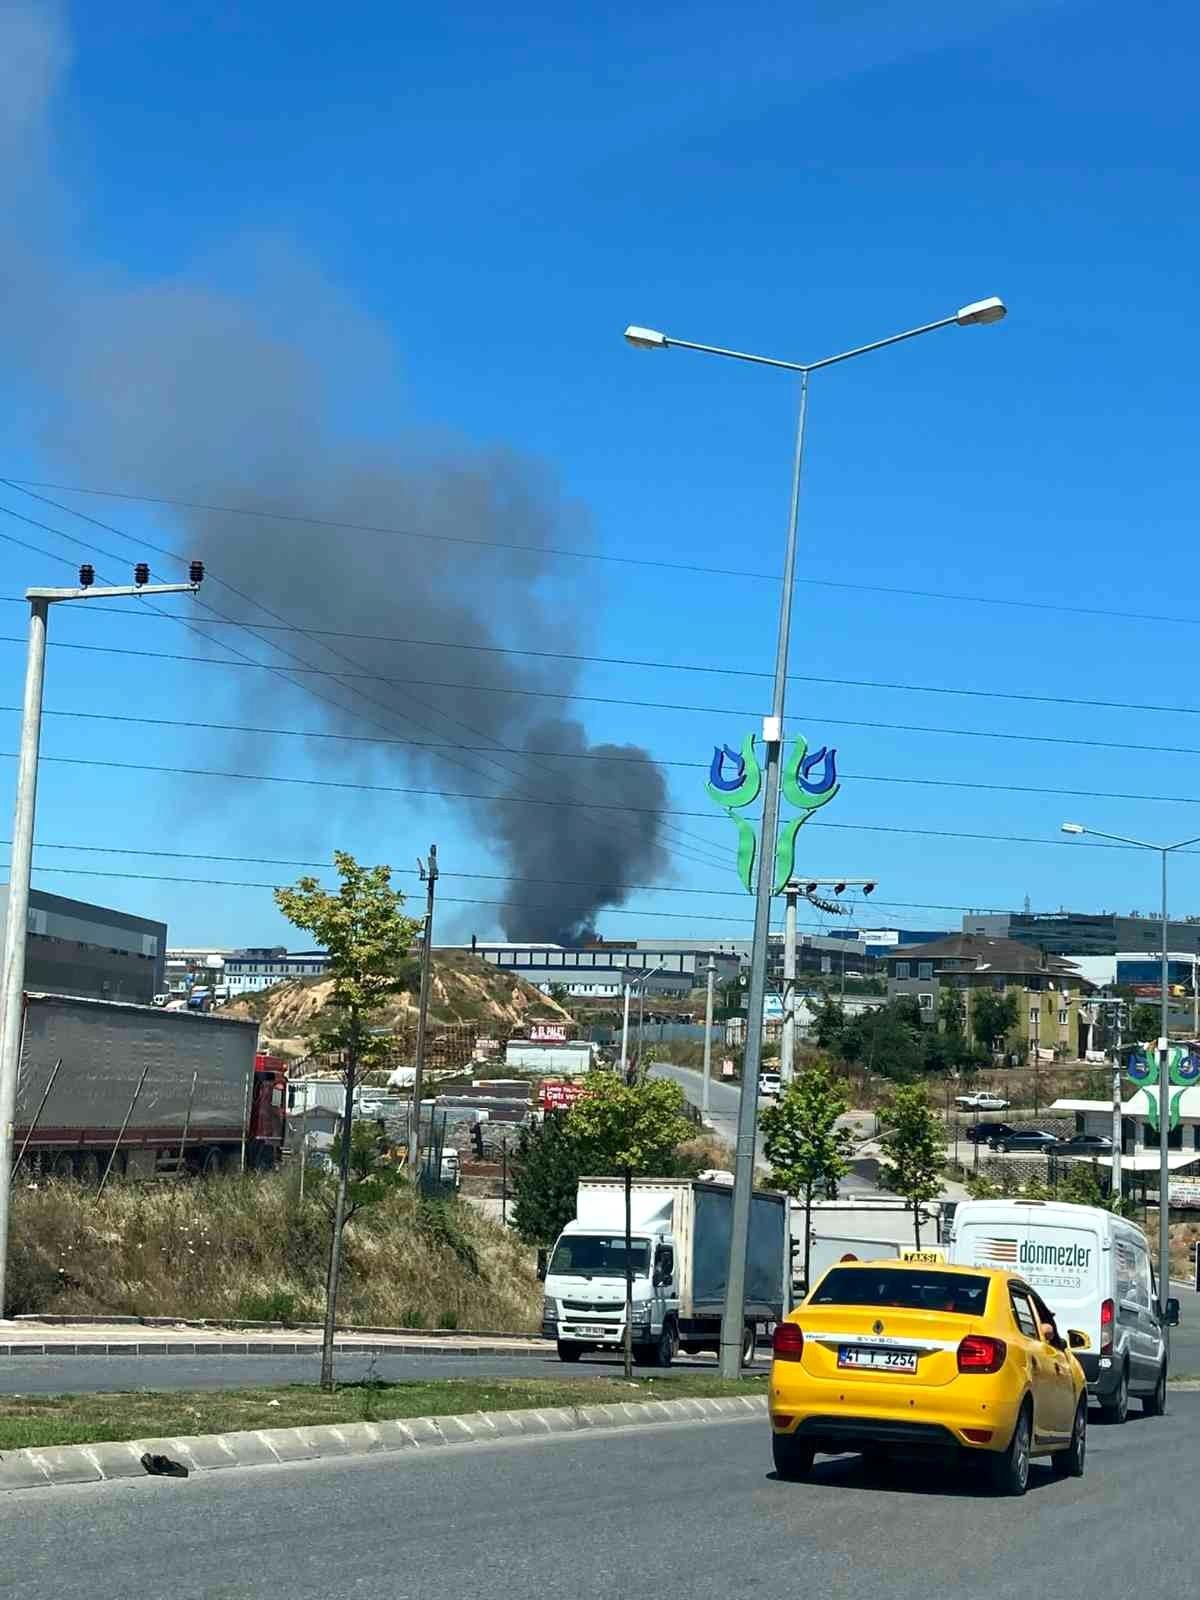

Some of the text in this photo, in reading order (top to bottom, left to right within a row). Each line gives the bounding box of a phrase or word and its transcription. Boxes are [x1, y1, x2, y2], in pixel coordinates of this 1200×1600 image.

[1019, 1239, 1091, 1268] dönmezler
[847, 1349, 915, 1367] 41 T 3254
